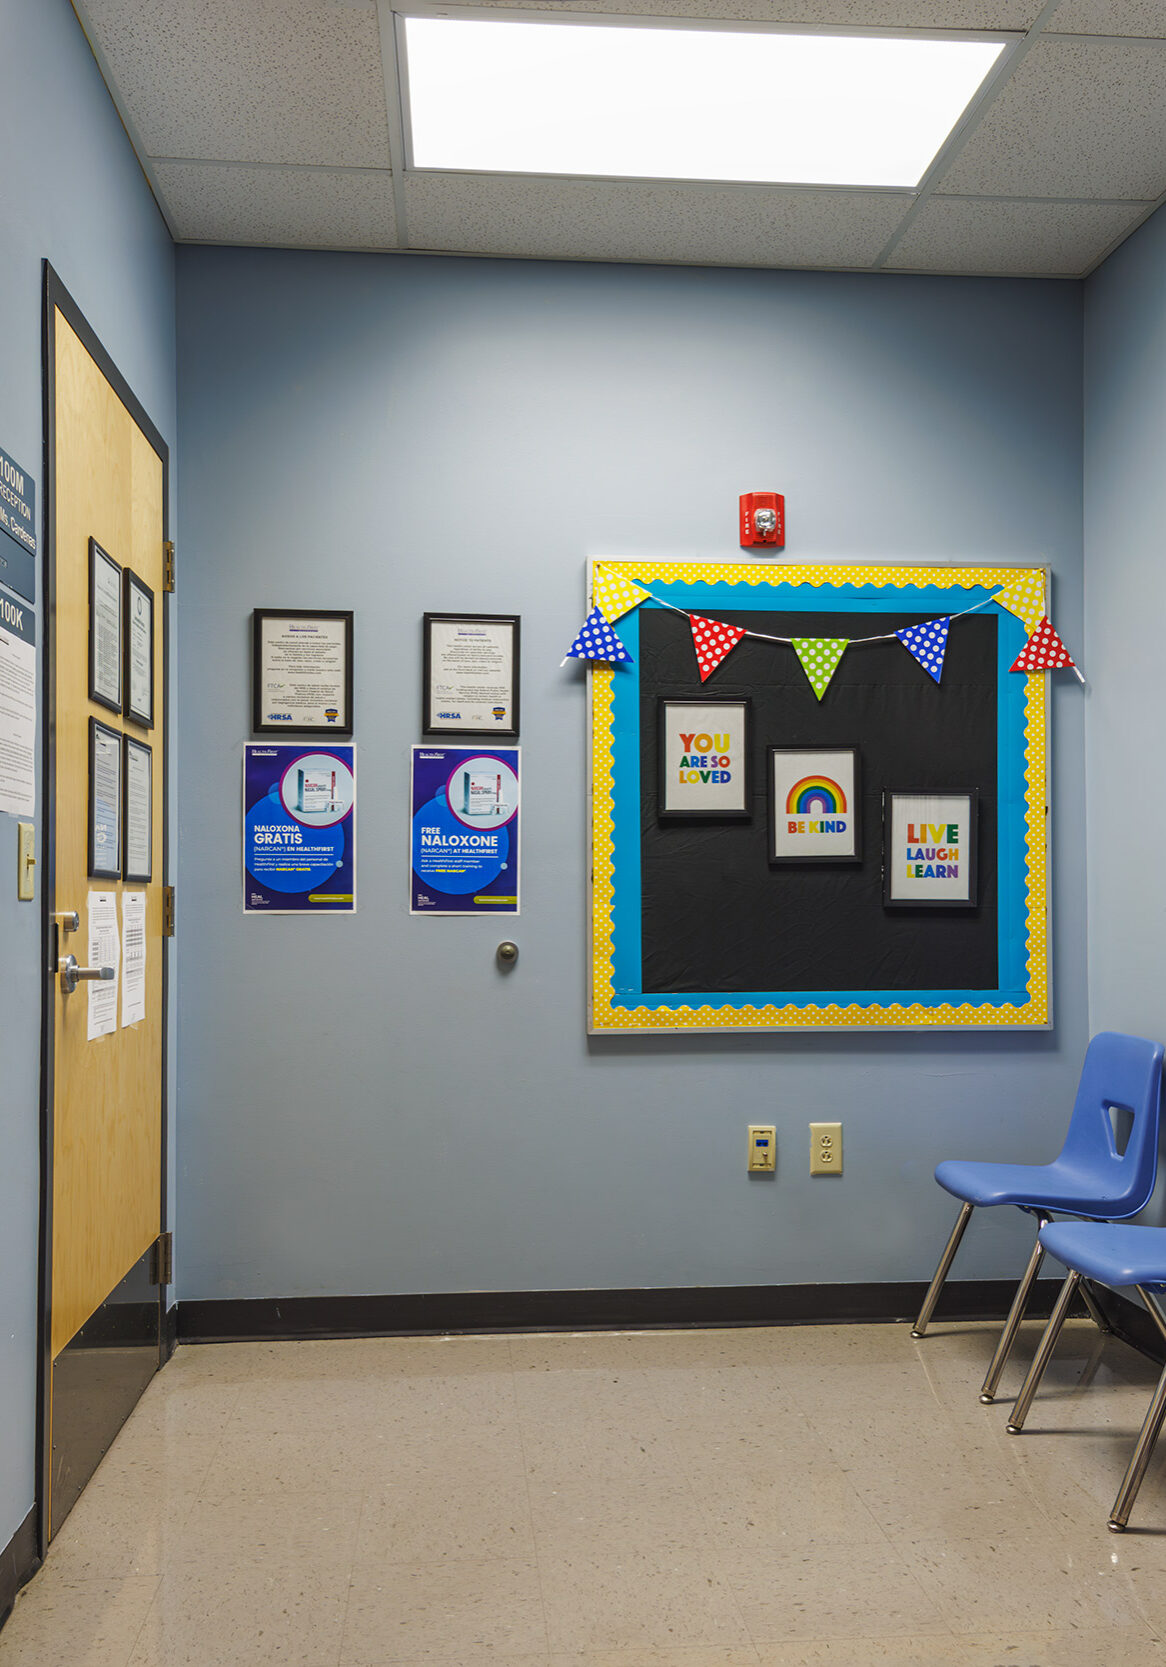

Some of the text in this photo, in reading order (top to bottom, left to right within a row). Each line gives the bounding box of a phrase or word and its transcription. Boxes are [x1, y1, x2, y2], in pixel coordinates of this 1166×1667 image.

[0, 456, 24, 496] 100M
[0, 480, 31, 521] RECEPTION
[0, 597, 24, 632] 100K
[679, 733, 730, 753] YOU
[680, 755, 730, 768] ARE SO
[679, 770, 731, 784] LOVED
[254, 825, 300, 833] NALOXONA
[788, 820, 847, 834] BE KIND
[907, 823, 959, 844] LIVE
[254, 833, 303, 844] GRATIS
[421, 835, 498, 846] NALOXONE
[906, 848, 959, 861] LAUGH
[906, 864, 959, 879] LEARN
